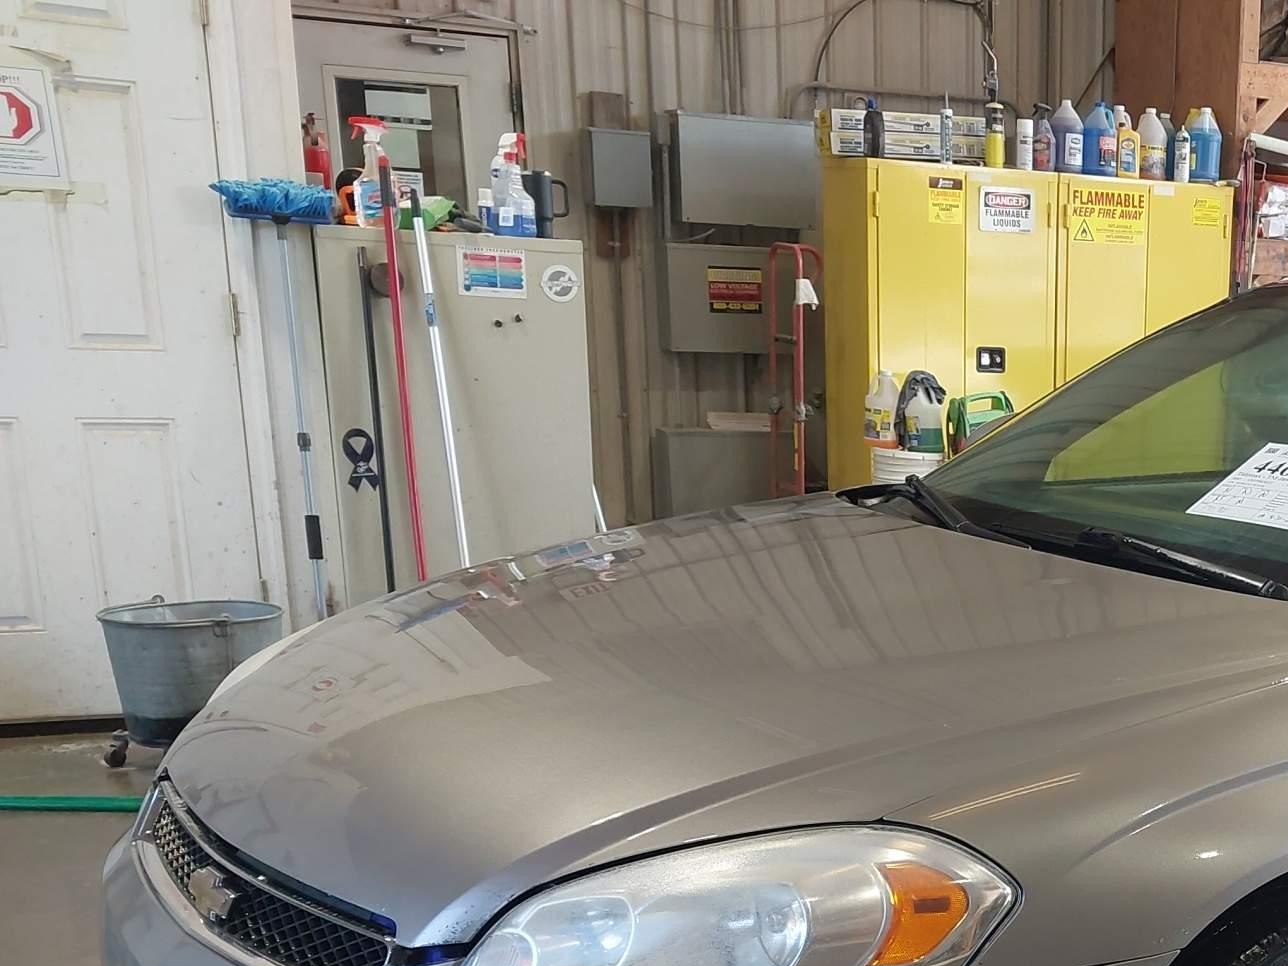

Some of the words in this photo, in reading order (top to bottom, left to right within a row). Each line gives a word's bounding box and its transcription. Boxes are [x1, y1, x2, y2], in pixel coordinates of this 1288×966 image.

[988, 194, 1026, 208] DANGER
[1072, 190, 1145, 209] FLAMMABLE
[985, 208, 1030, 219] FLAMMABLE
[1072, 207, 1095, 217] KEEP
[1097, 208, 1117, 219] FIRE
[1118, 209, 1144, 220] AWAY
[992, 218, 1021, 228] LIQUIDS
